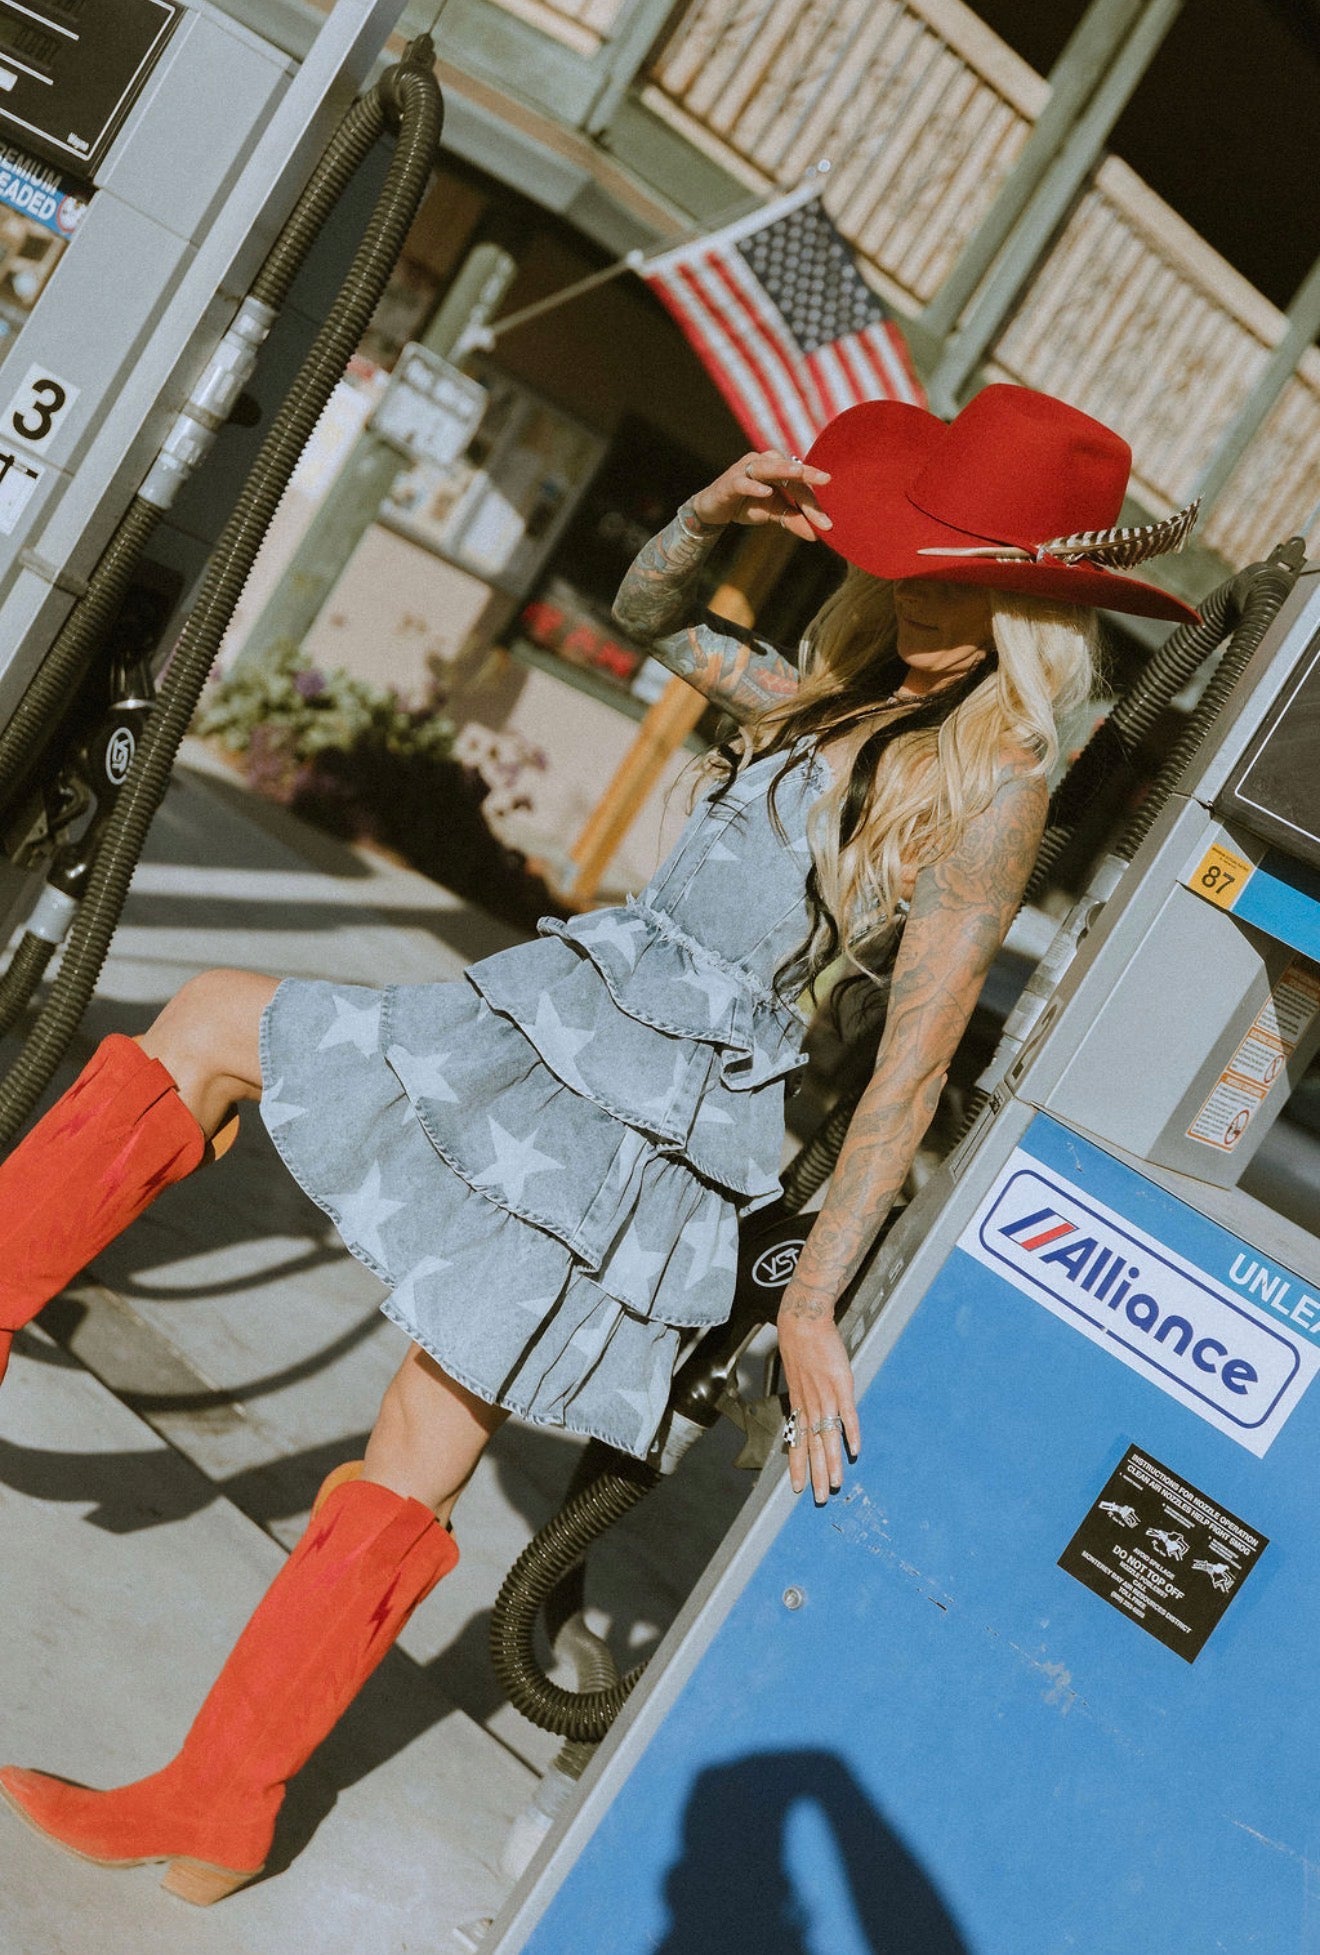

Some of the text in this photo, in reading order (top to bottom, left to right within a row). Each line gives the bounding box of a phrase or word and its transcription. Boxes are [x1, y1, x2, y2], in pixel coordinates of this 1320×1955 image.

[12, 379, 67, 441] 3
[1201, 864, 1236, 895] 87
[760, 1247, 800, 1281] VST
[1039, 1236, 1259, 1395] Alliance
[1126, 1464, 1150, 1484] CLEAN
[1148, 1480, 1162, 1492] AIR
[1160, 1488, 1192, 1514] NOZZLES
[1190, 1509, 1210, 1526] HELP
[1208, 1522, 1230, 1541] FIGHT
[1228, 1537, 1251, 1555] SMOG
[1131, 1453, 1180, 1491] INSTRUCTIONS
[1178, 1487, 1194, 1501] FOR
[1192, 1497, 1220, 1519] NOZZLE
[1219, 1515, 1258, 1546] OPERATION
[1111, 1544, 1185, 1601] DO NOT TOP OFF
[1118, 1560, 1140, 1579] NOZZLE
[1132, 1547, 1150, 1562] AVOID
[1080, 1550, 1112, 1575] MONTEREY
[1110, 1571, 1123, 1584] BAY
[1121, 1580, 1133, 1591] AIR
[1131, 1587, 1166, 1615] RESOURCES
[1165, 1611, 1191, 1633] DISTRICT
[1117, 1586, 1132, 1599] TOLL
[1131, 1579, 1147, 1592] CALL
